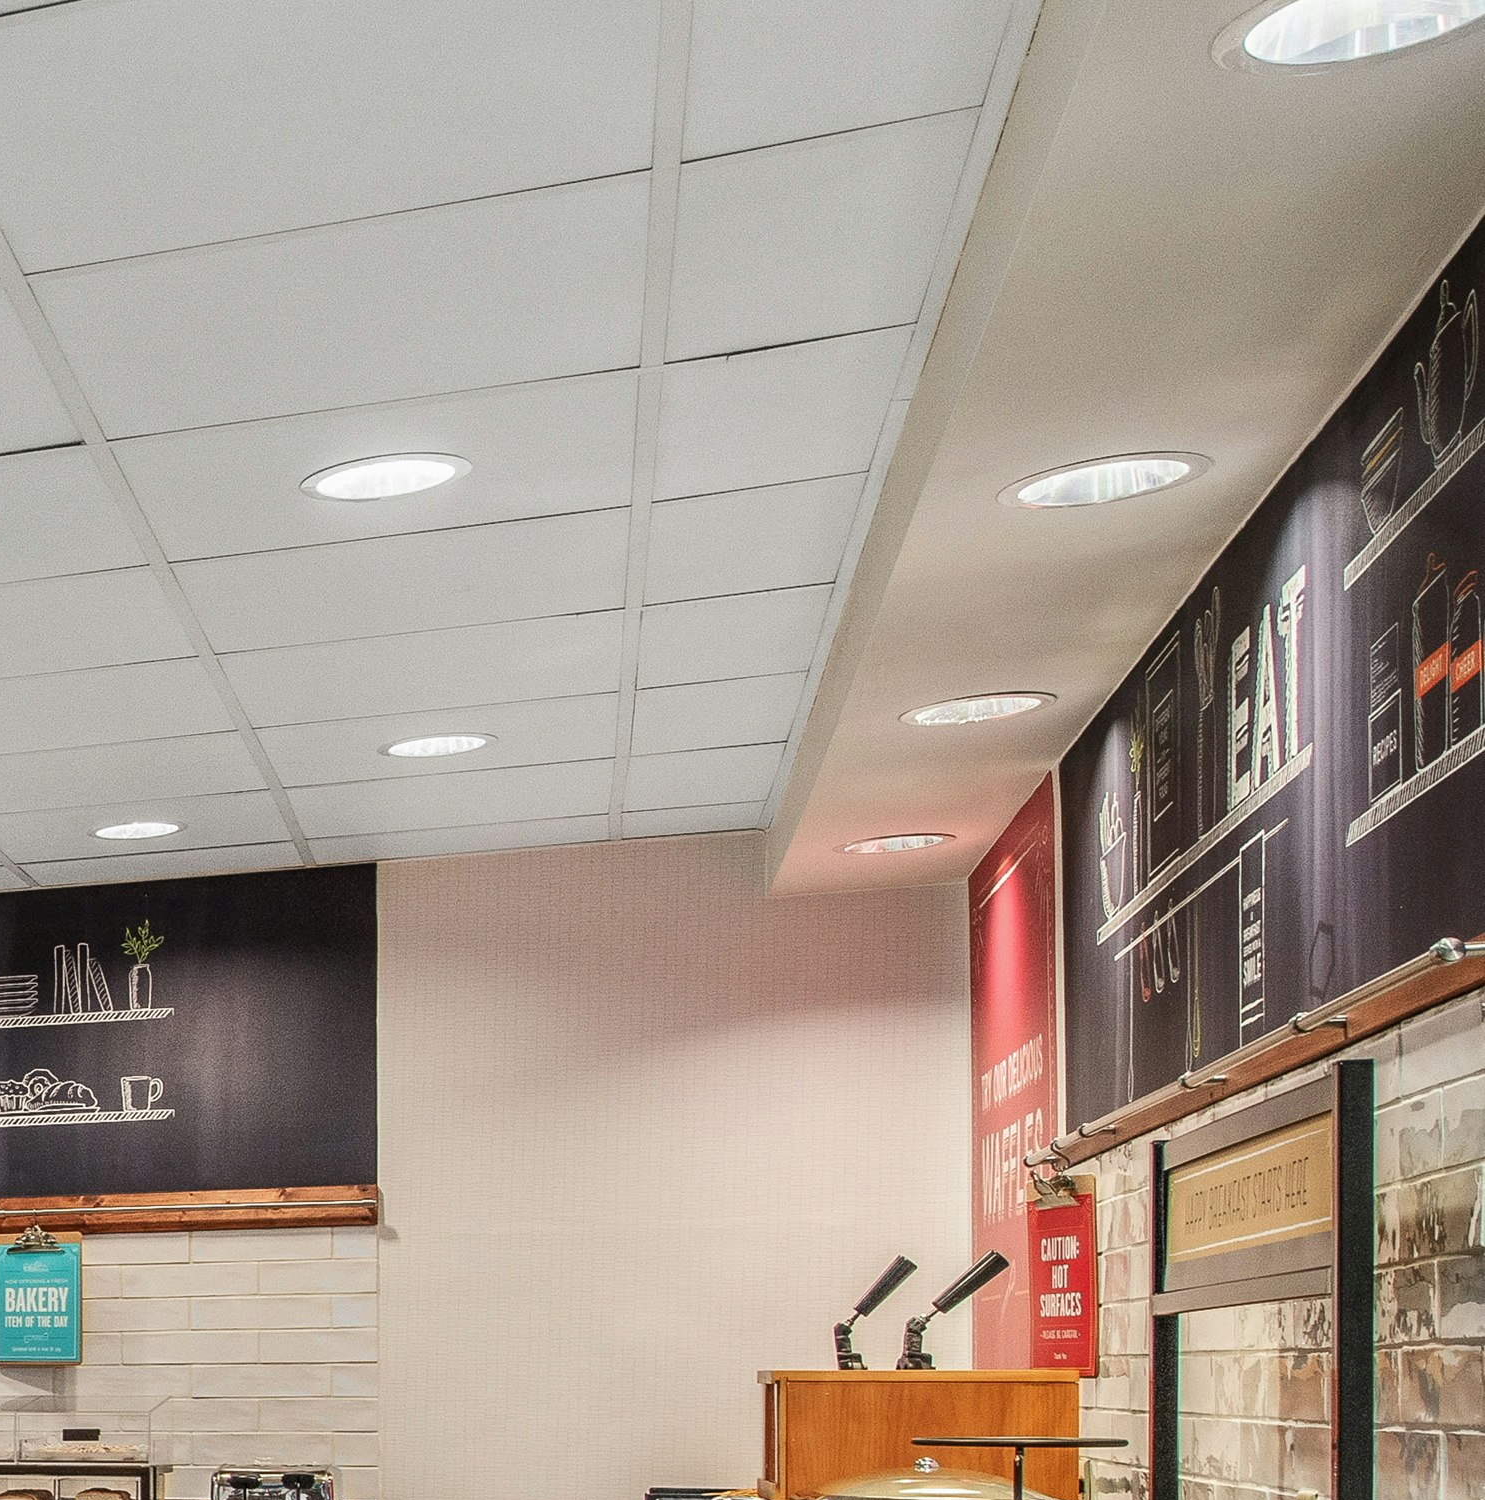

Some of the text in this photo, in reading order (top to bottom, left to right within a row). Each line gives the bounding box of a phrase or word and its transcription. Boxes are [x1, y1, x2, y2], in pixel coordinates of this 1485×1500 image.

[1455, 650, 1476, 682] CHEER
[1227, 564, 1306, 813] EAT
[1372, 729, 1398, 767] RECIPES
[981, 1032, 1043, 1112] TRY OUR DELICIOUS
[1040, 1235, 1080, 1262] CAUTION:
[1051, 1264, 1069, 1289] HOT
[5, 1286, 69, 1313] BAKERY
[1039, 1292, 1082, 1318] SURFACES
[4, 1315, 69, 1328] ITEM OF THE DAY
